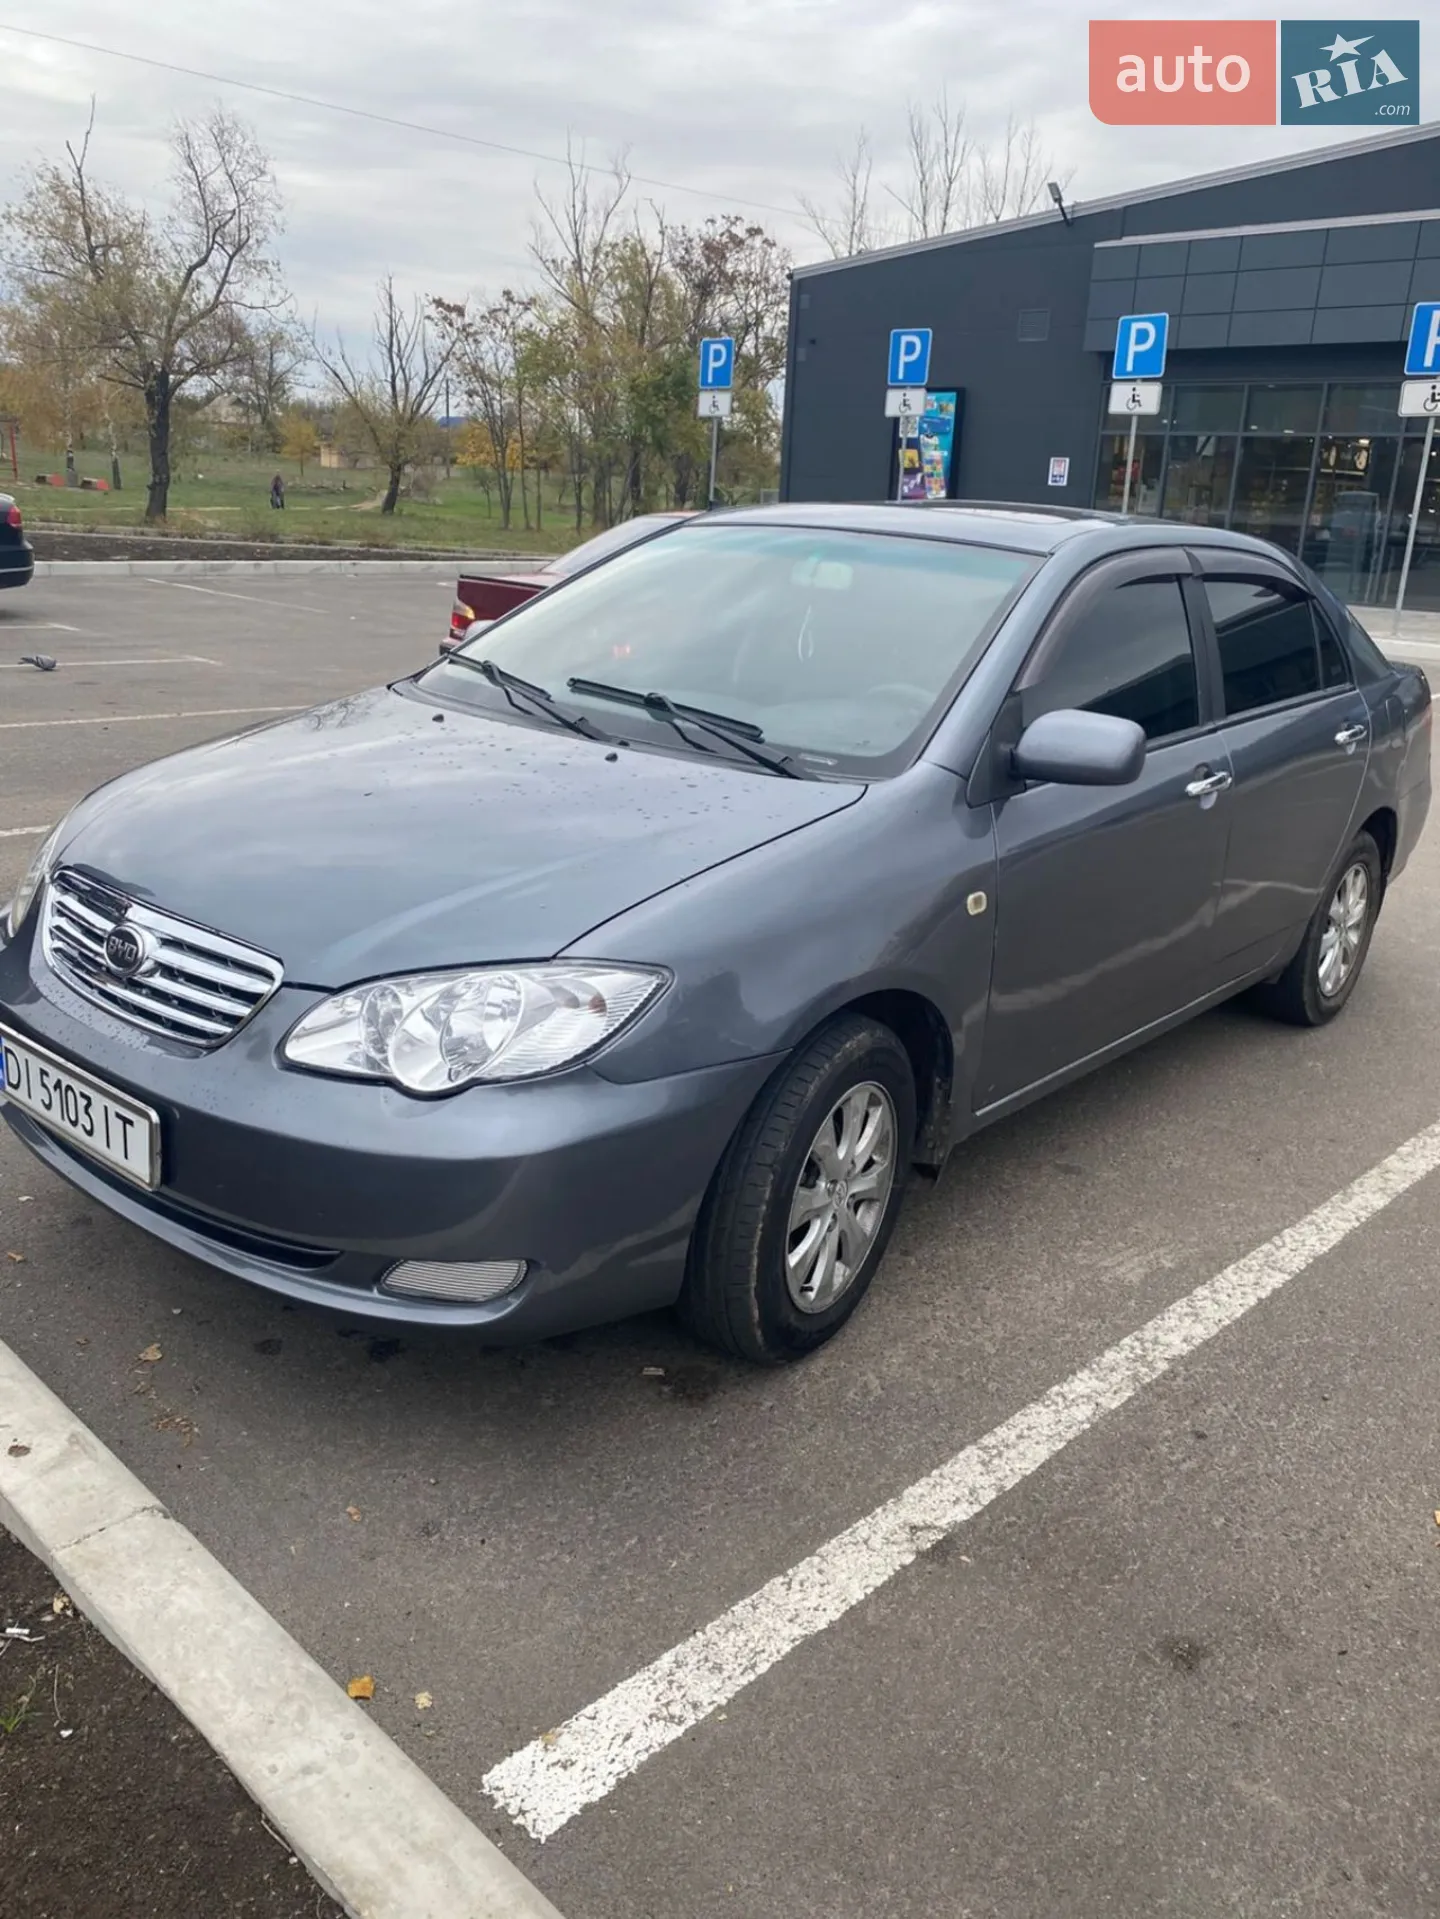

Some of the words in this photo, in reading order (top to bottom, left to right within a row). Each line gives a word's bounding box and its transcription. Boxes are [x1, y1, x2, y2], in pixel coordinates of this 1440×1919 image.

[707, 343, 727, 383] P
[898, 335, 921, 380] P
[1126, 321, 1156, 372] P
[39, 1067, 94, 1137] 5103
[103, 1104, 135, 1160] IT
